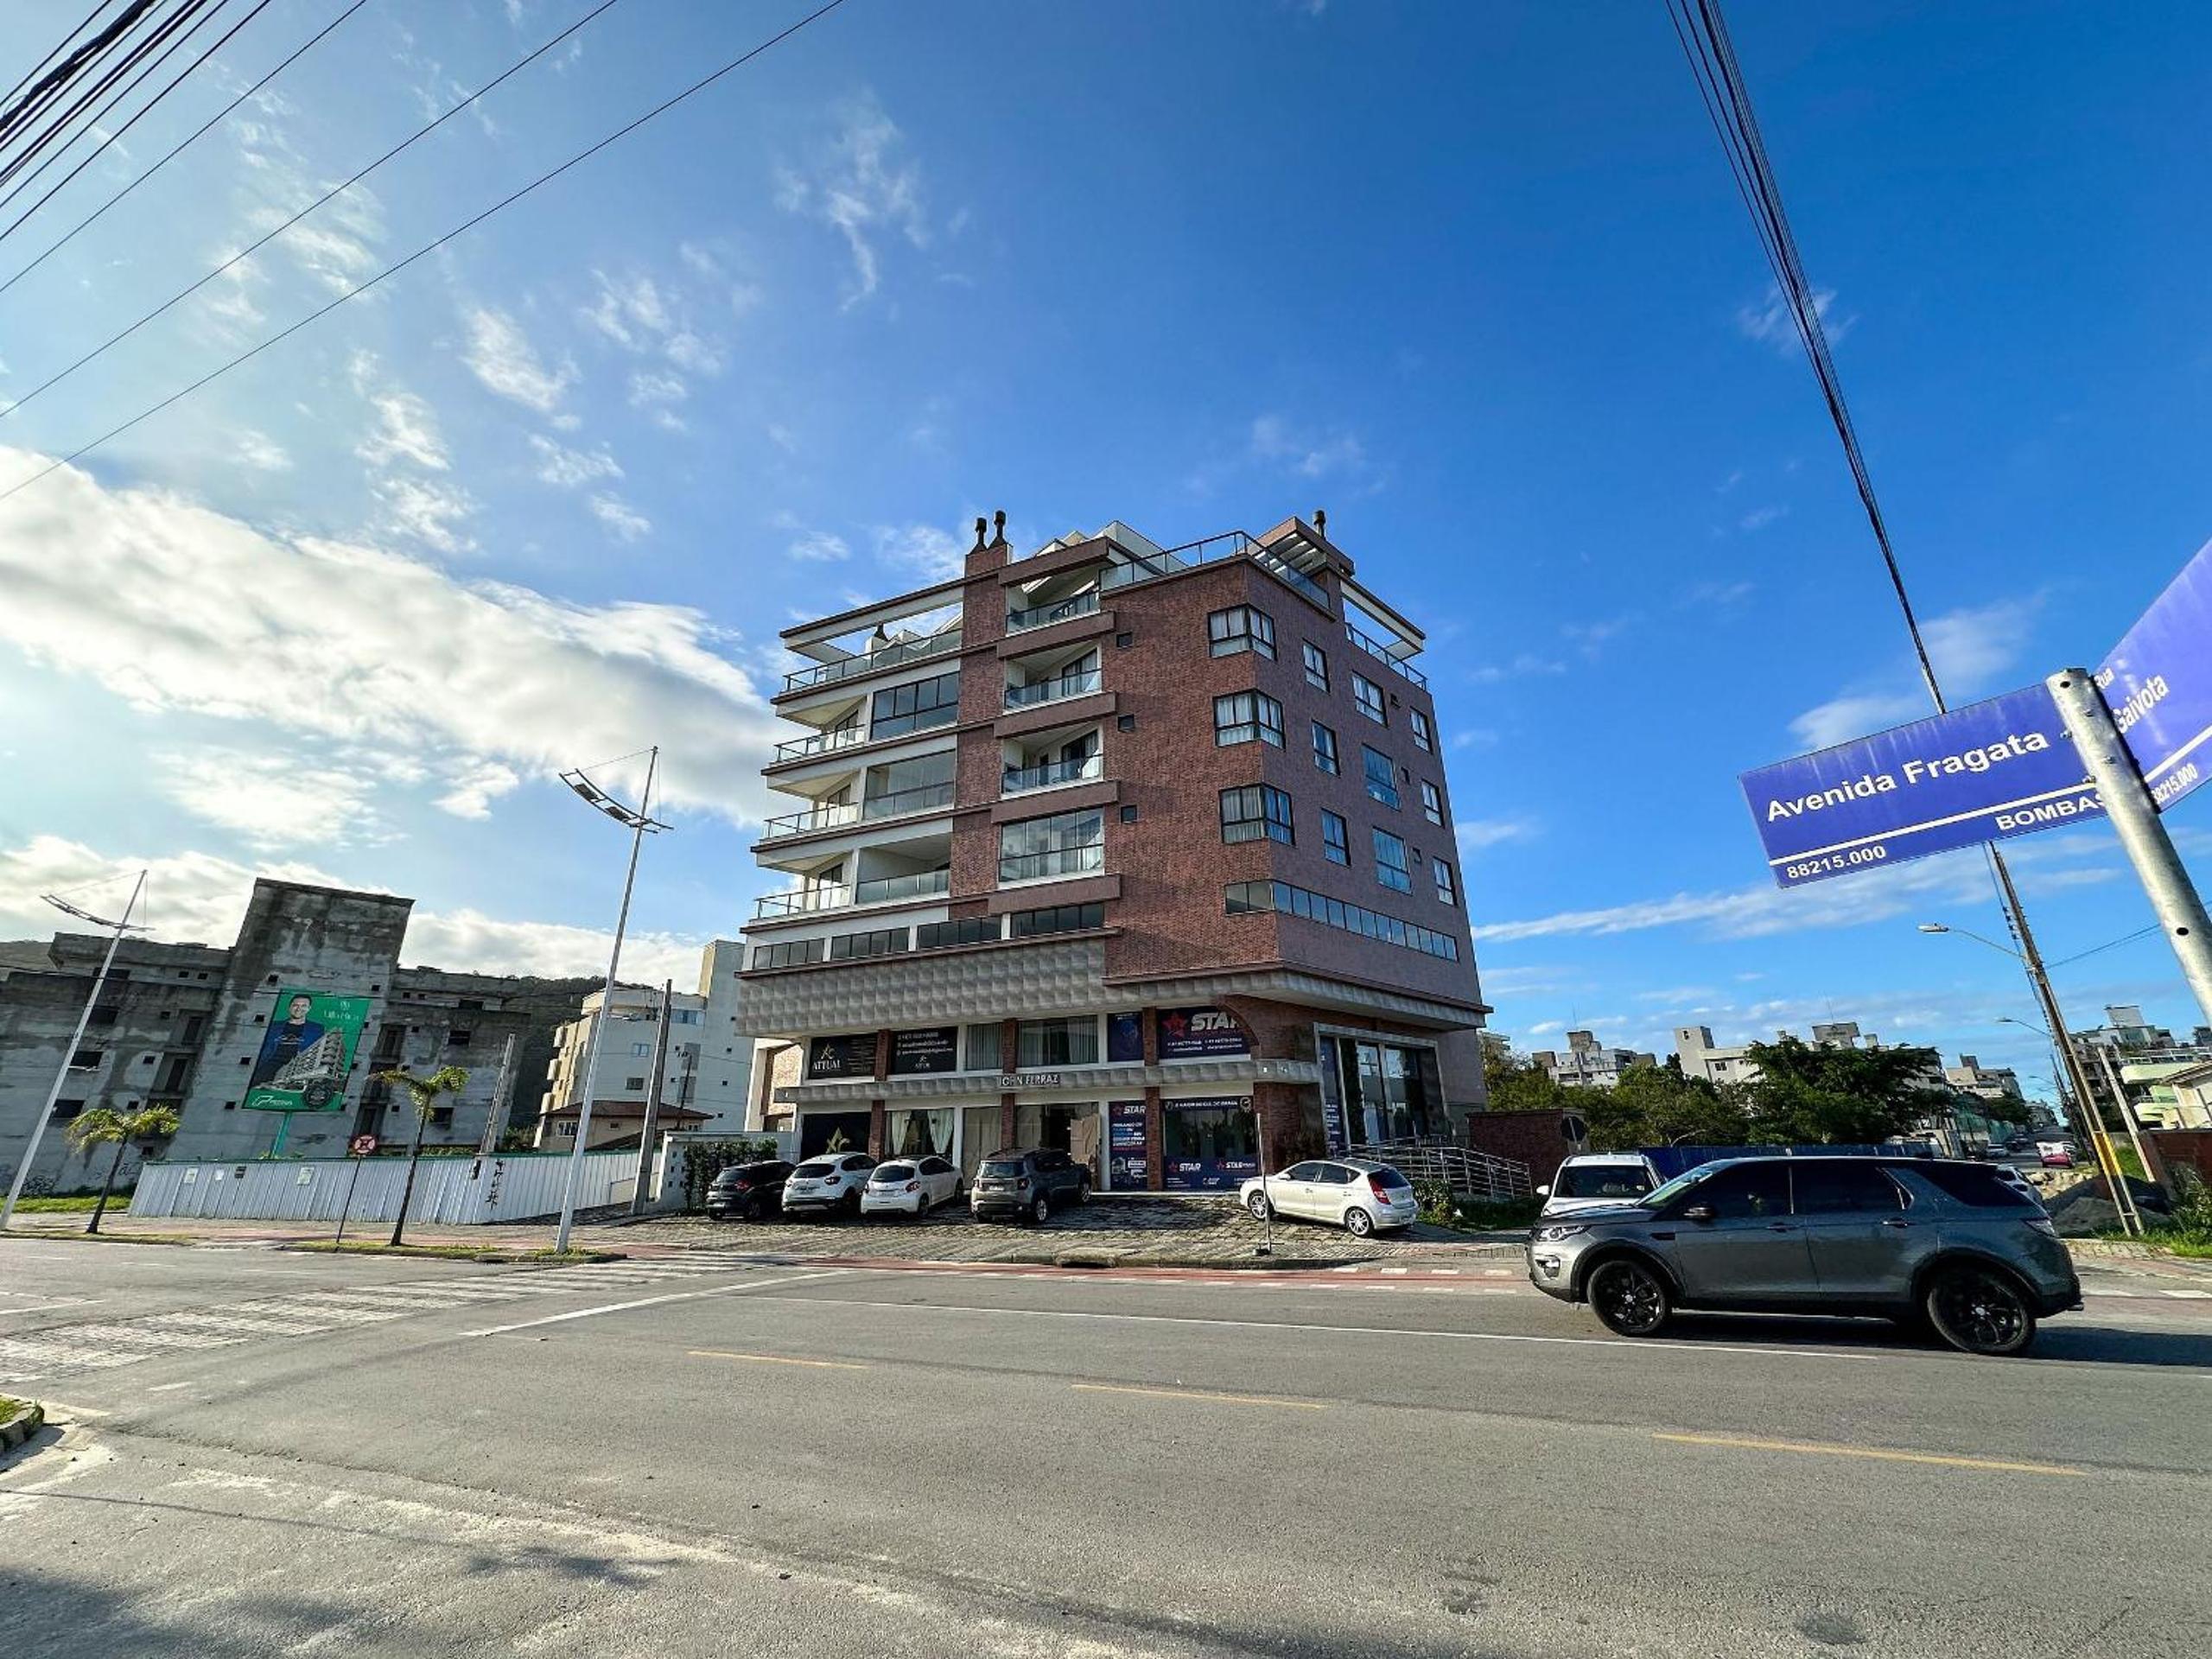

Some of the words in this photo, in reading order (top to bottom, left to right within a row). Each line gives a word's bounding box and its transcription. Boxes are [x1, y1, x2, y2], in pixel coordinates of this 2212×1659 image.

[2094, 668, 2114, 690] Rua
[2112, 675, 2170, 734] Gaivota
[1768, 774, 1897, 822] Avenida
[1902, 732, 2050, 784] Fragata
[1787, 846, 1886, 878] 88215.000
[1123, 1105, 1146, 1114] STAR
[1179, 1162, 1201, 1172] STAR
